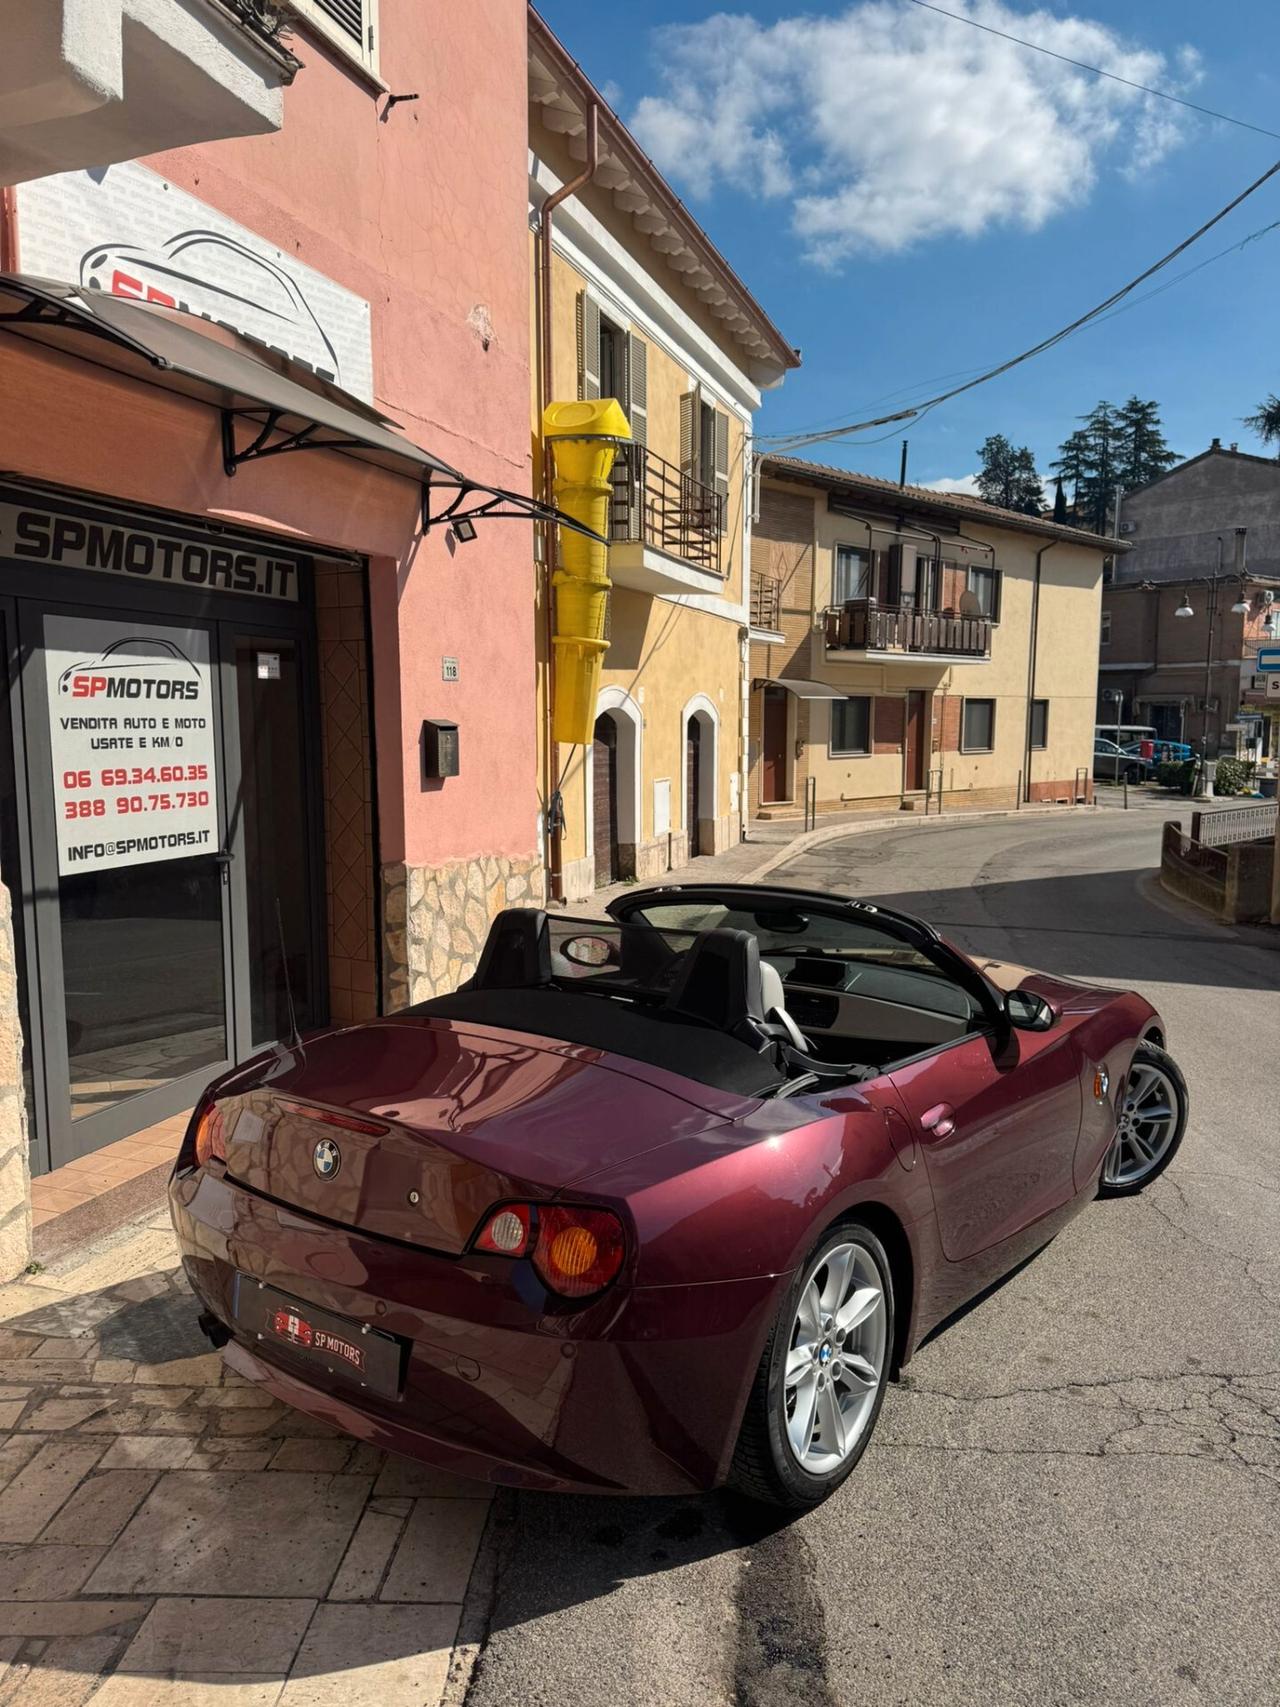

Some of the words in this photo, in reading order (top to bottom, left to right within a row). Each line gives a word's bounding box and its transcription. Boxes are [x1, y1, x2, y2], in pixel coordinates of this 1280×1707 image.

[14, 511, 294, 597] SPMOTORS.IT
[446, 666, 457, 677] 118
[72, 675, 199, 700] SPMOTORS
[60, 717, 118, 730] VENDITA
[123, 717, 157, 729] AUTO
[162, 718, 169, 729] E
[175, 718, 206, 729] MOTO
[91, 737, 134, 750] USATE
[139, 737, 147, 748] E
[63, 770, 92, 789] 06
[101, 764, 208, 786] 69.34.60.35
[64, 799, 106, 820] 388
[116, 790, 209, 814] 90.75.730
[68, 829, 210, 862] INFO@SPMOTORS.IT
[314, 1331, 326, 1347] SP
[326, 1335, 361, 1365] MOTORS
